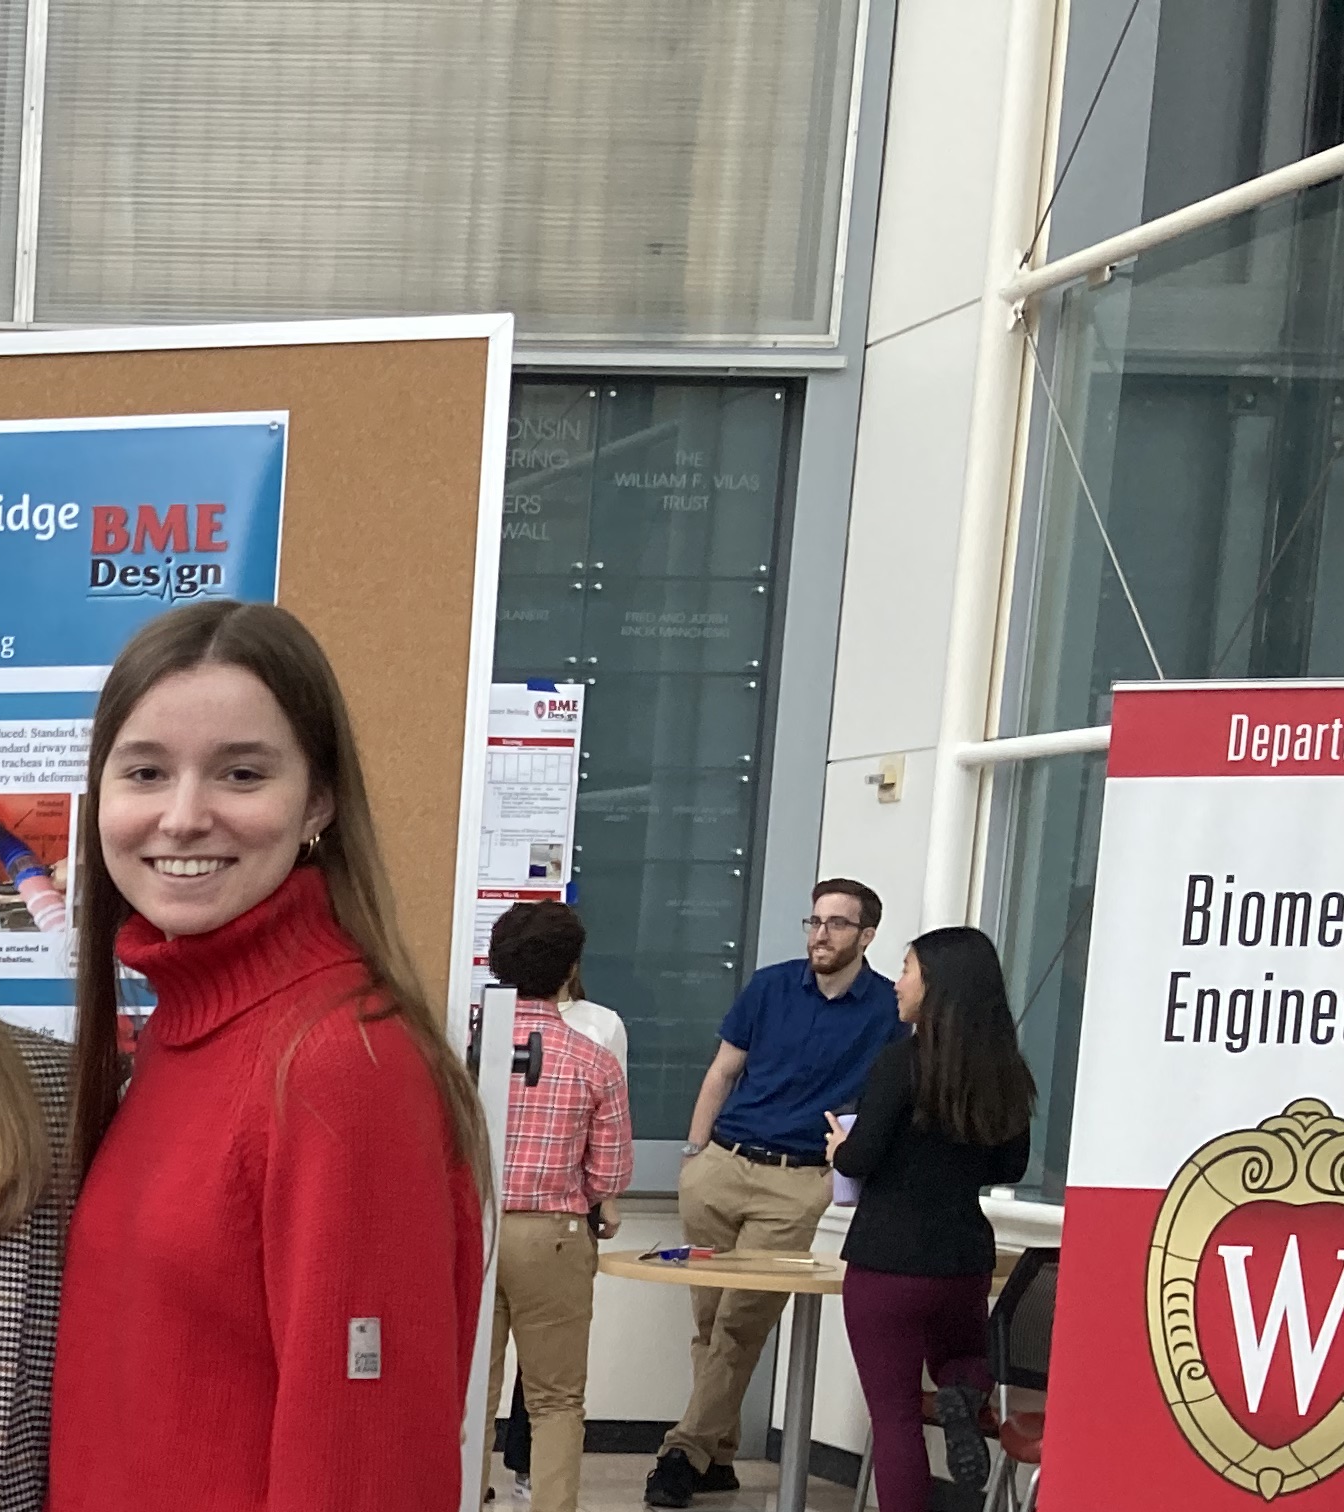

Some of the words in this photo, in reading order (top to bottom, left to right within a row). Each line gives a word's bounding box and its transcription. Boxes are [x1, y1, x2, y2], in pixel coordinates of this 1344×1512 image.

[508, 416, 581, 442] ONSIN
[615, 472, 686, 489] WILLIAM
[713, 473, 761, 492] VILAS
[662, 495, 710, 512] TRUST
[91, 504, 229, 554] BME
[89, 557, 223, 598] Design
[548, 699, 579, 712] BME
[31, 727, 79, 738] Standard,
[1227, 713, 1344, 768] Depart
[32, 743, 67, 755] airway
[1, 759, 42, 768] tracheas
[14, 772, 36, 782] with
[38, 772, 85, 782] deformat
[1182, 874, 1344, 948] Biome
[1164, 971, 1344, 1053] Engine
